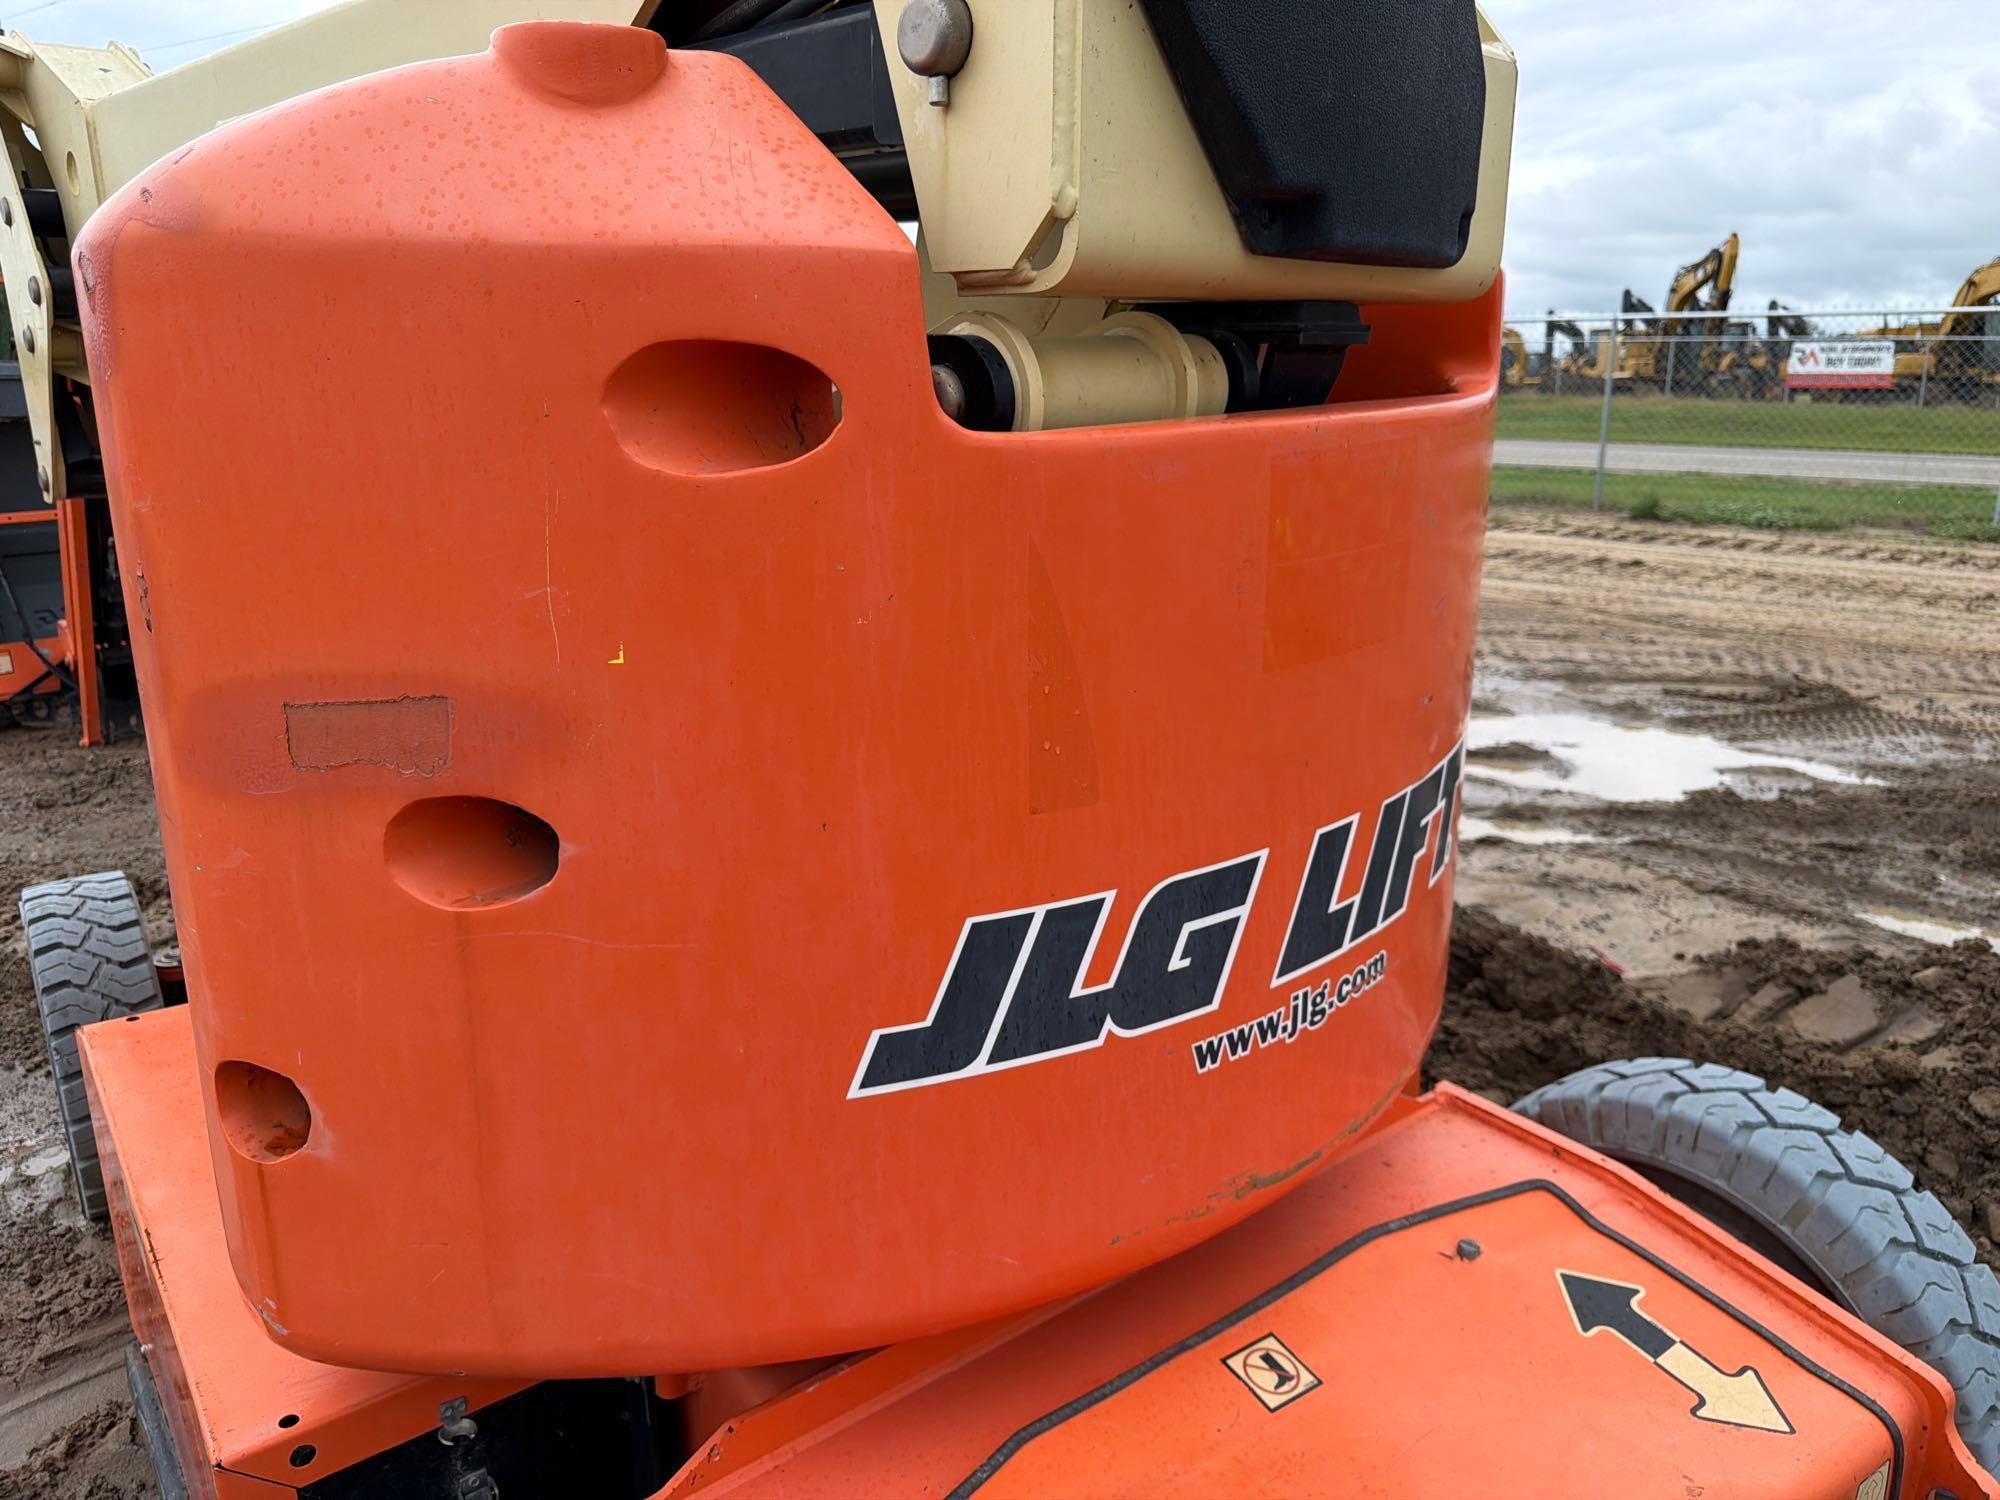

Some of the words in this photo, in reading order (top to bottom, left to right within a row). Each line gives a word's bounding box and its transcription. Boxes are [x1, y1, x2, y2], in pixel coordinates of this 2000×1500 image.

[846, 848, 1269, 1099] JLG
[1270, 735, 1465, 988] LIFT
[1192, 950, 1386, 1073] www.jlg.com
